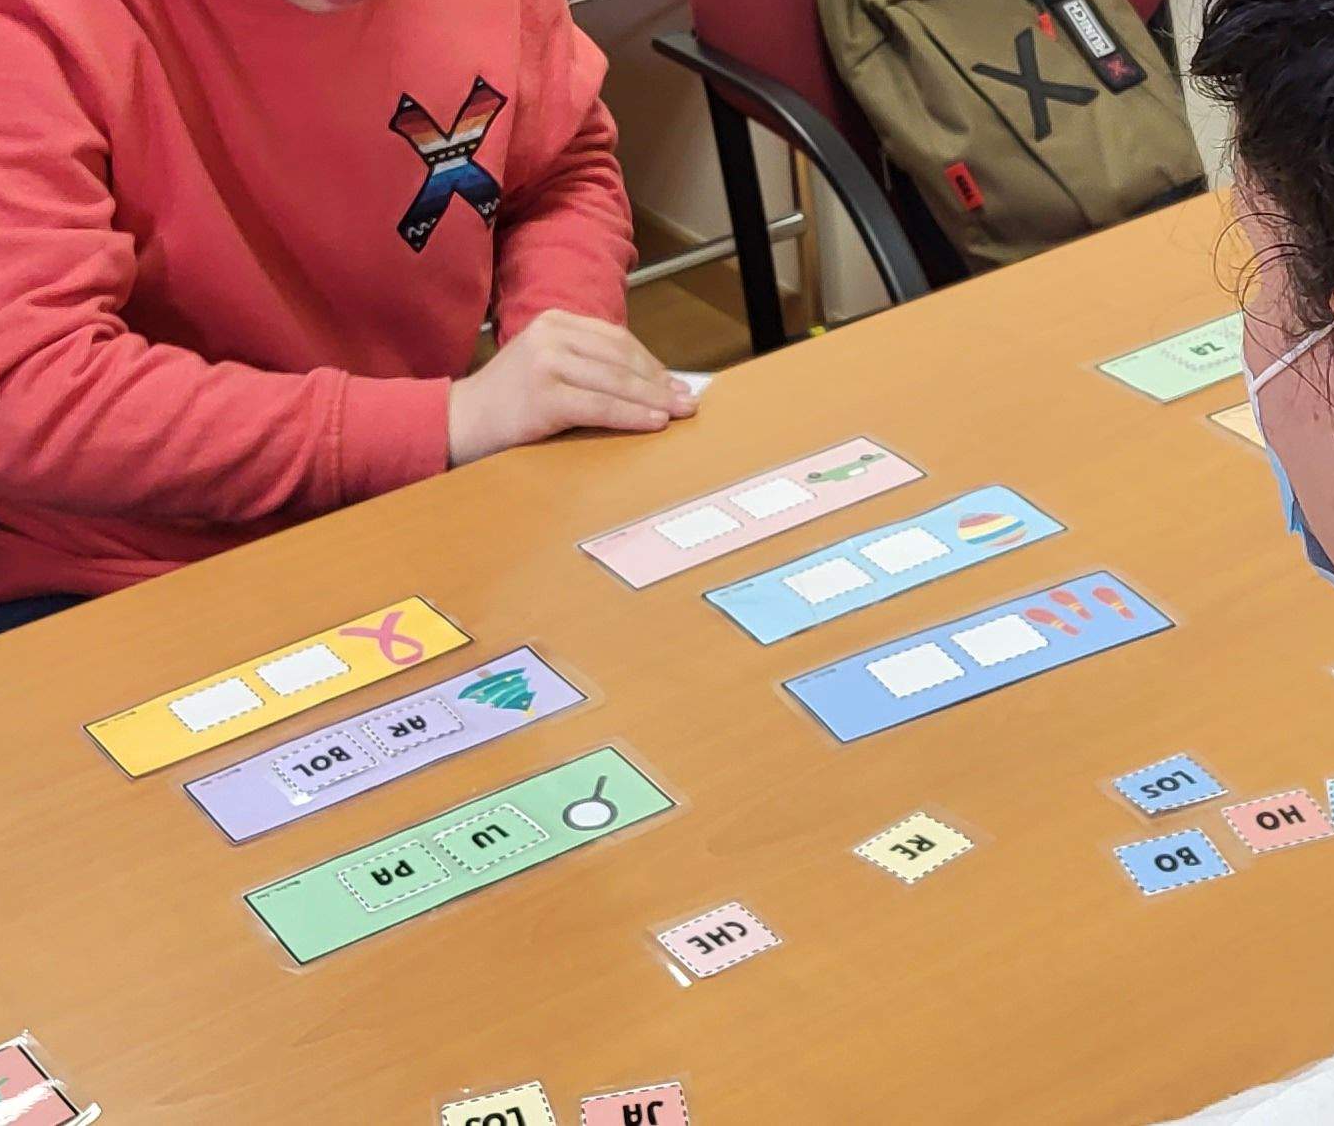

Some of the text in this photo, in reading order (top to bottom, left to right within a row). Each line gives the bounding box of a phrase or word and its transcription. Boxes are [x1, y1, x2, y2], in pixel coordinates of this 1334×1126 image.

[291, 744, 351, 779] BOL
[1140, 770, 1197, 801] LOS
[1255, 804, 1306, 831] HO
[370, 823, 509, 888] LU PA
[889, 833, 937, 862] RE
[1154, 845, 1202, 873] BO
[685, 921, 749, 956] CHE
[622, 1100, 664, 1126] JA
